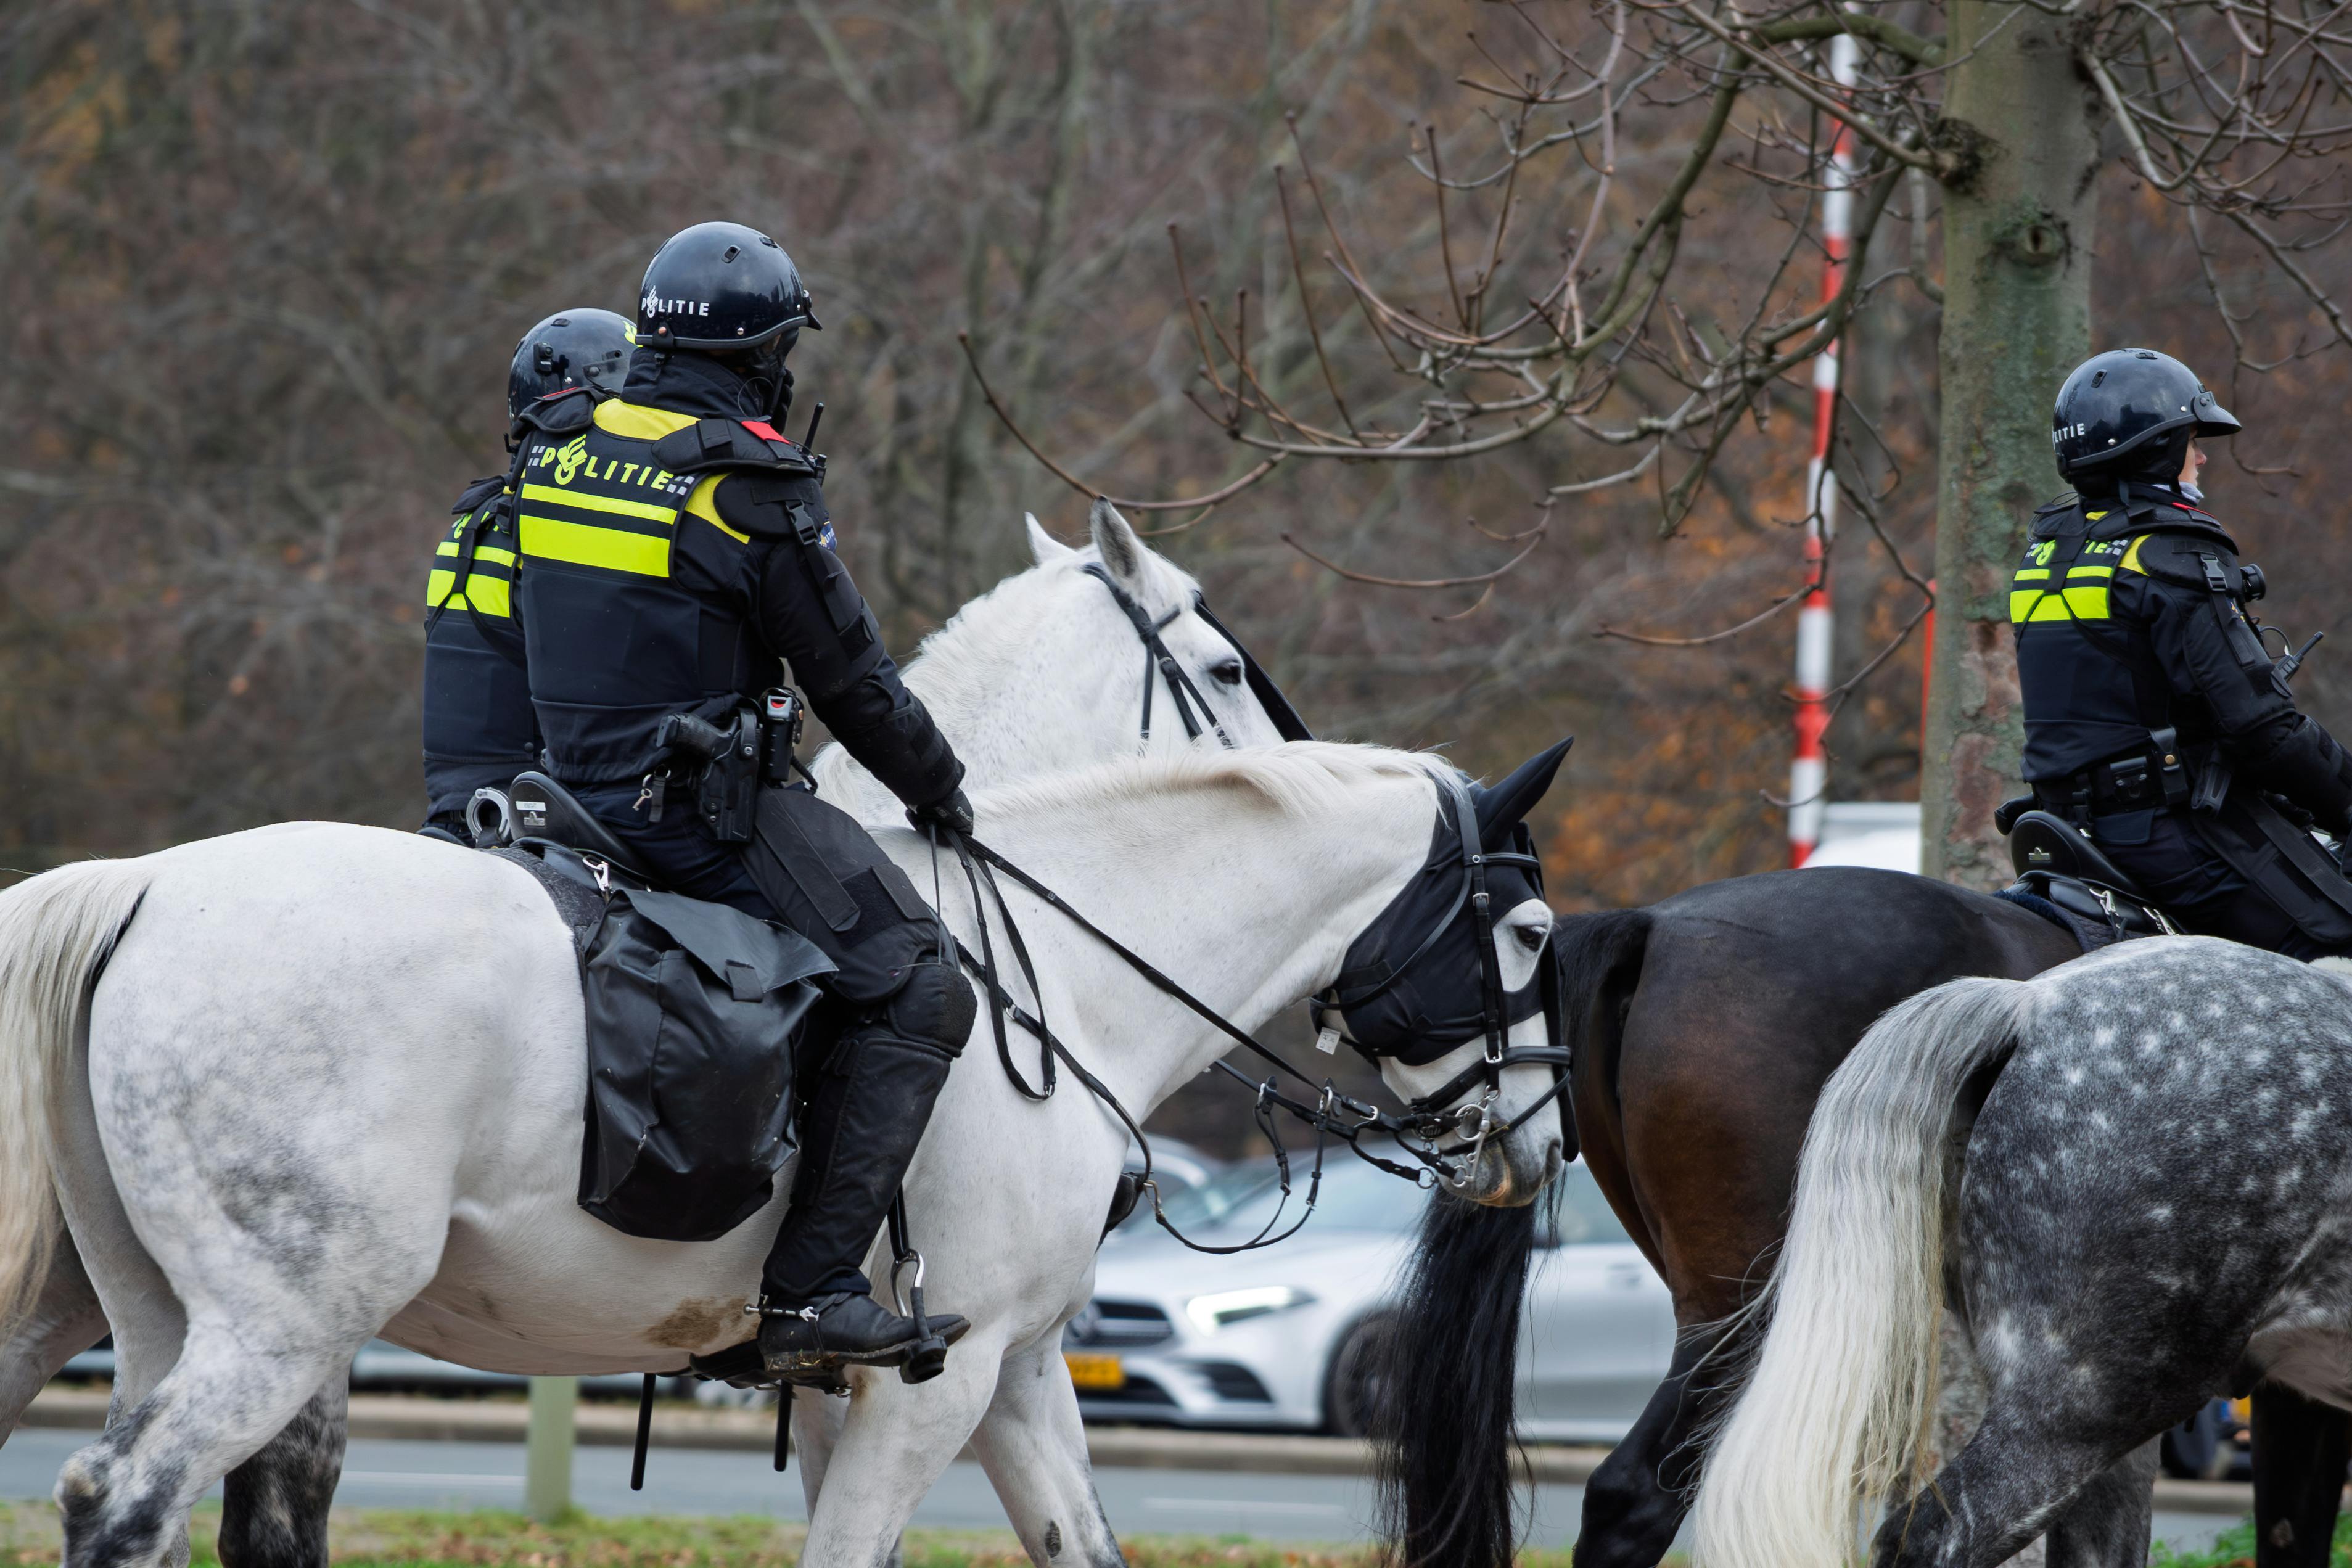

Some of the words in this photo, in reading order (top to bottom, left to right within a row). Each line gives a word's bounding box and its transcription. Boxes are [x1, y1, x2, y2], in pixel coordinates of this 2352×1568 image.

[641, 287, 709, 318] POLITIE
[2052, 423, 2085, 444] LITIE
[539, 434, 674, 490] POLITIE
